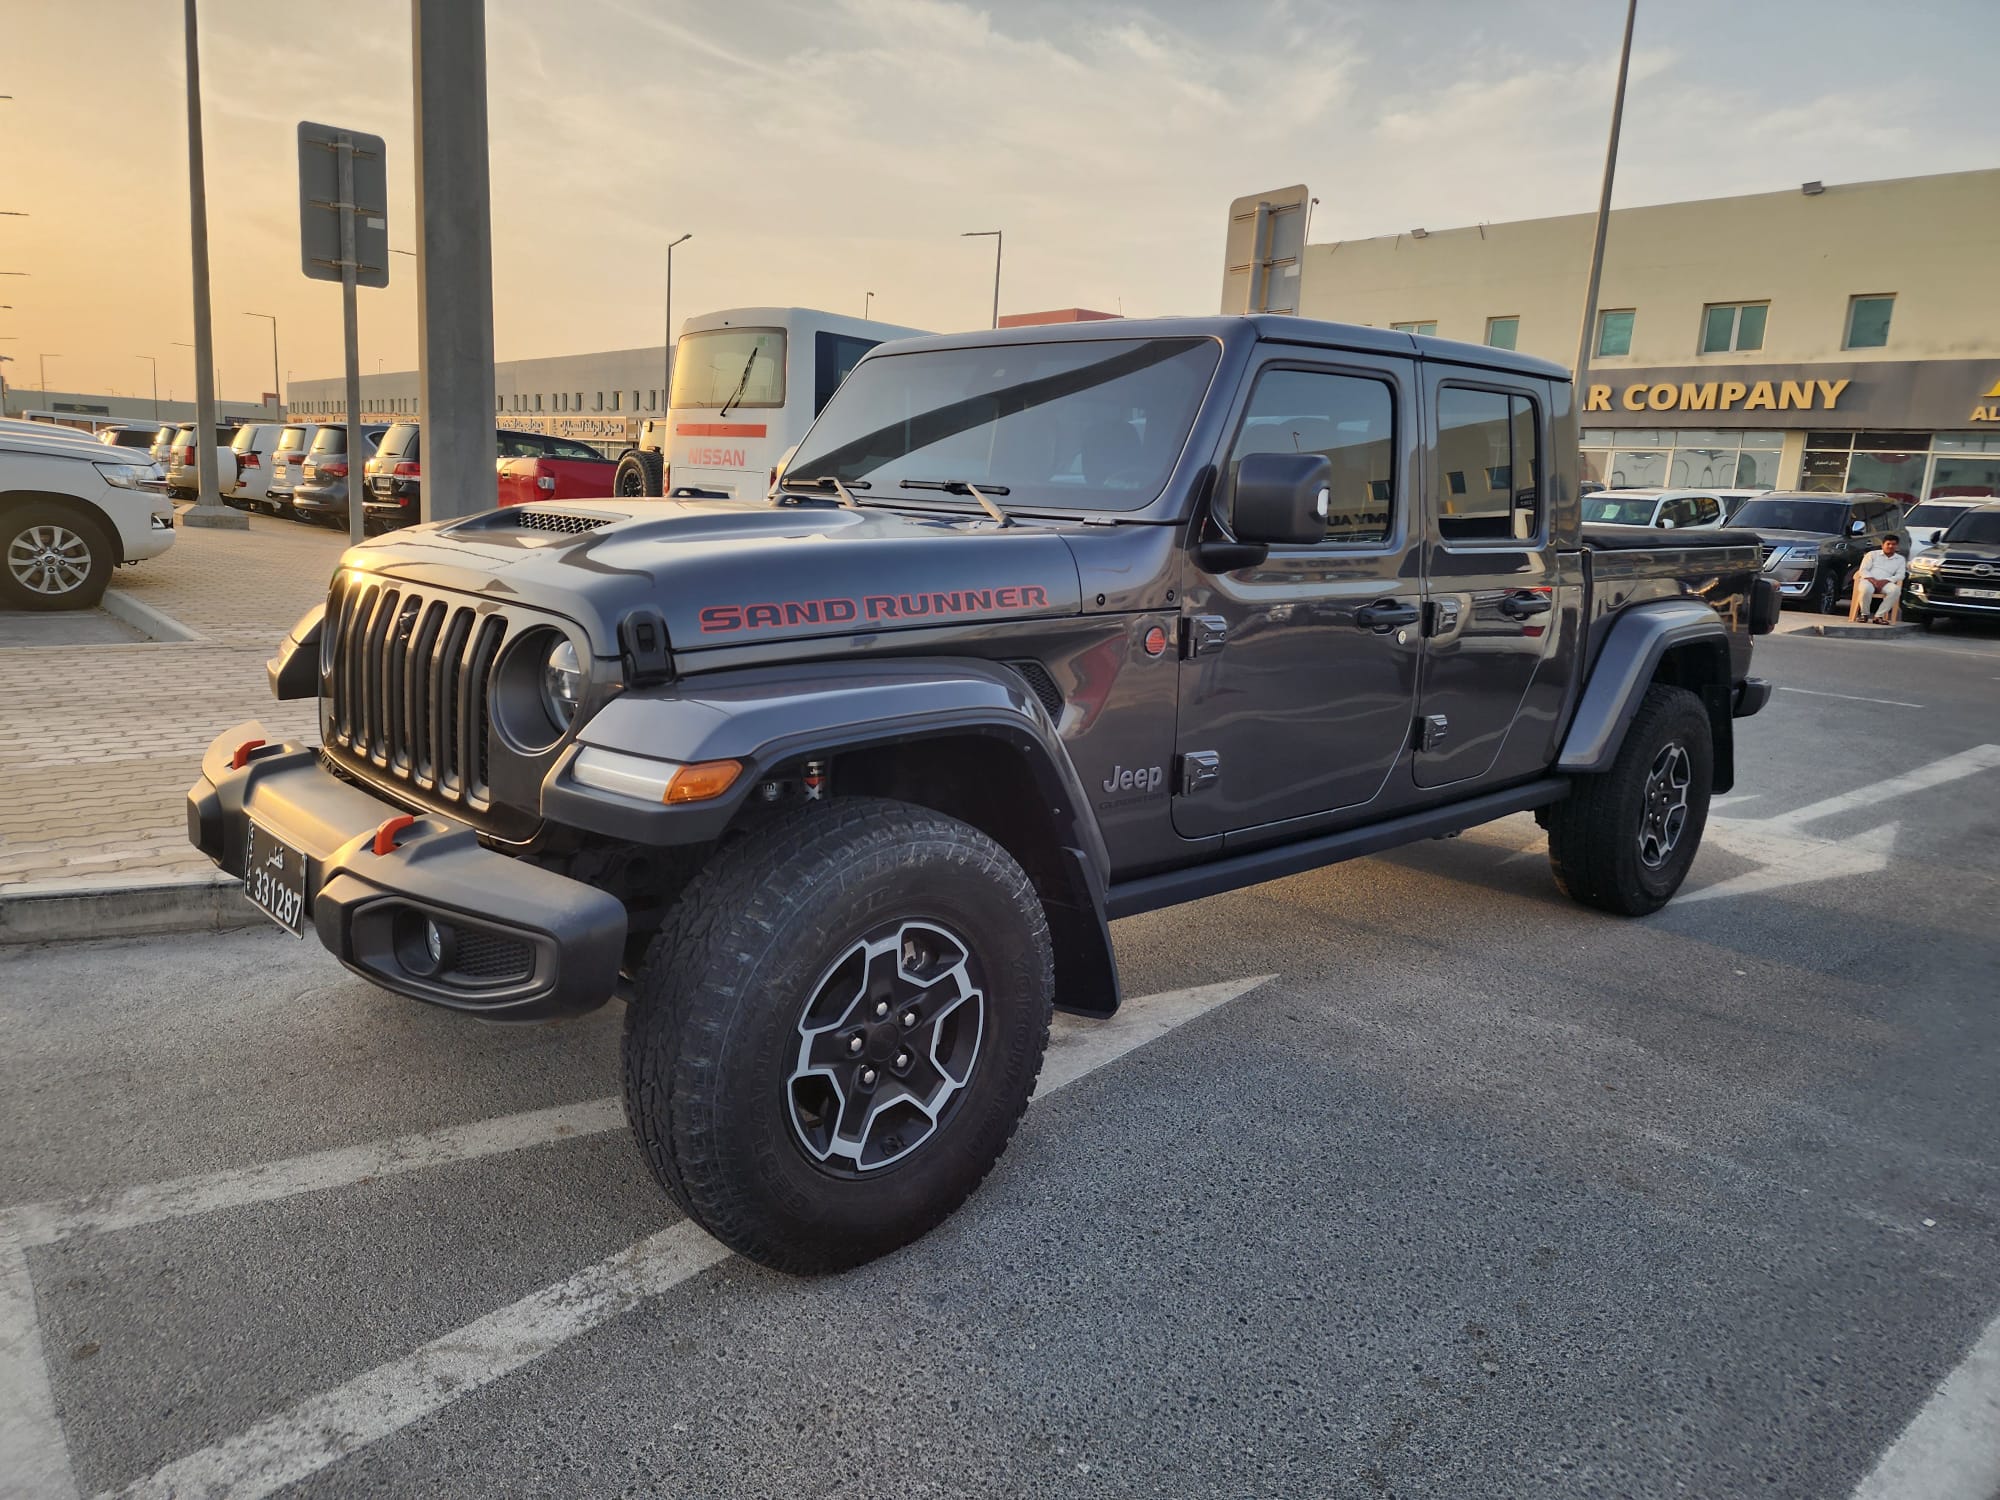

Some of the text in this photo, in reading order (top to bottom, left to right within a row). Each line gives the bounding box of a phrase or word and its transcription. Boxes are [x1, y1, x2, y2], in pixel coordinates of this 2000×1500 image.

[1622, 379, 1850, 411] COMPANY
[688, 447, 745, 467] NISSAN
[699, 585, 1050, 634] SAND RUNNER
[1103, 765, 1163, 793] Jeep
[266, 845, 285, 869] قطر
[255, 867, 302, 928] 331287
